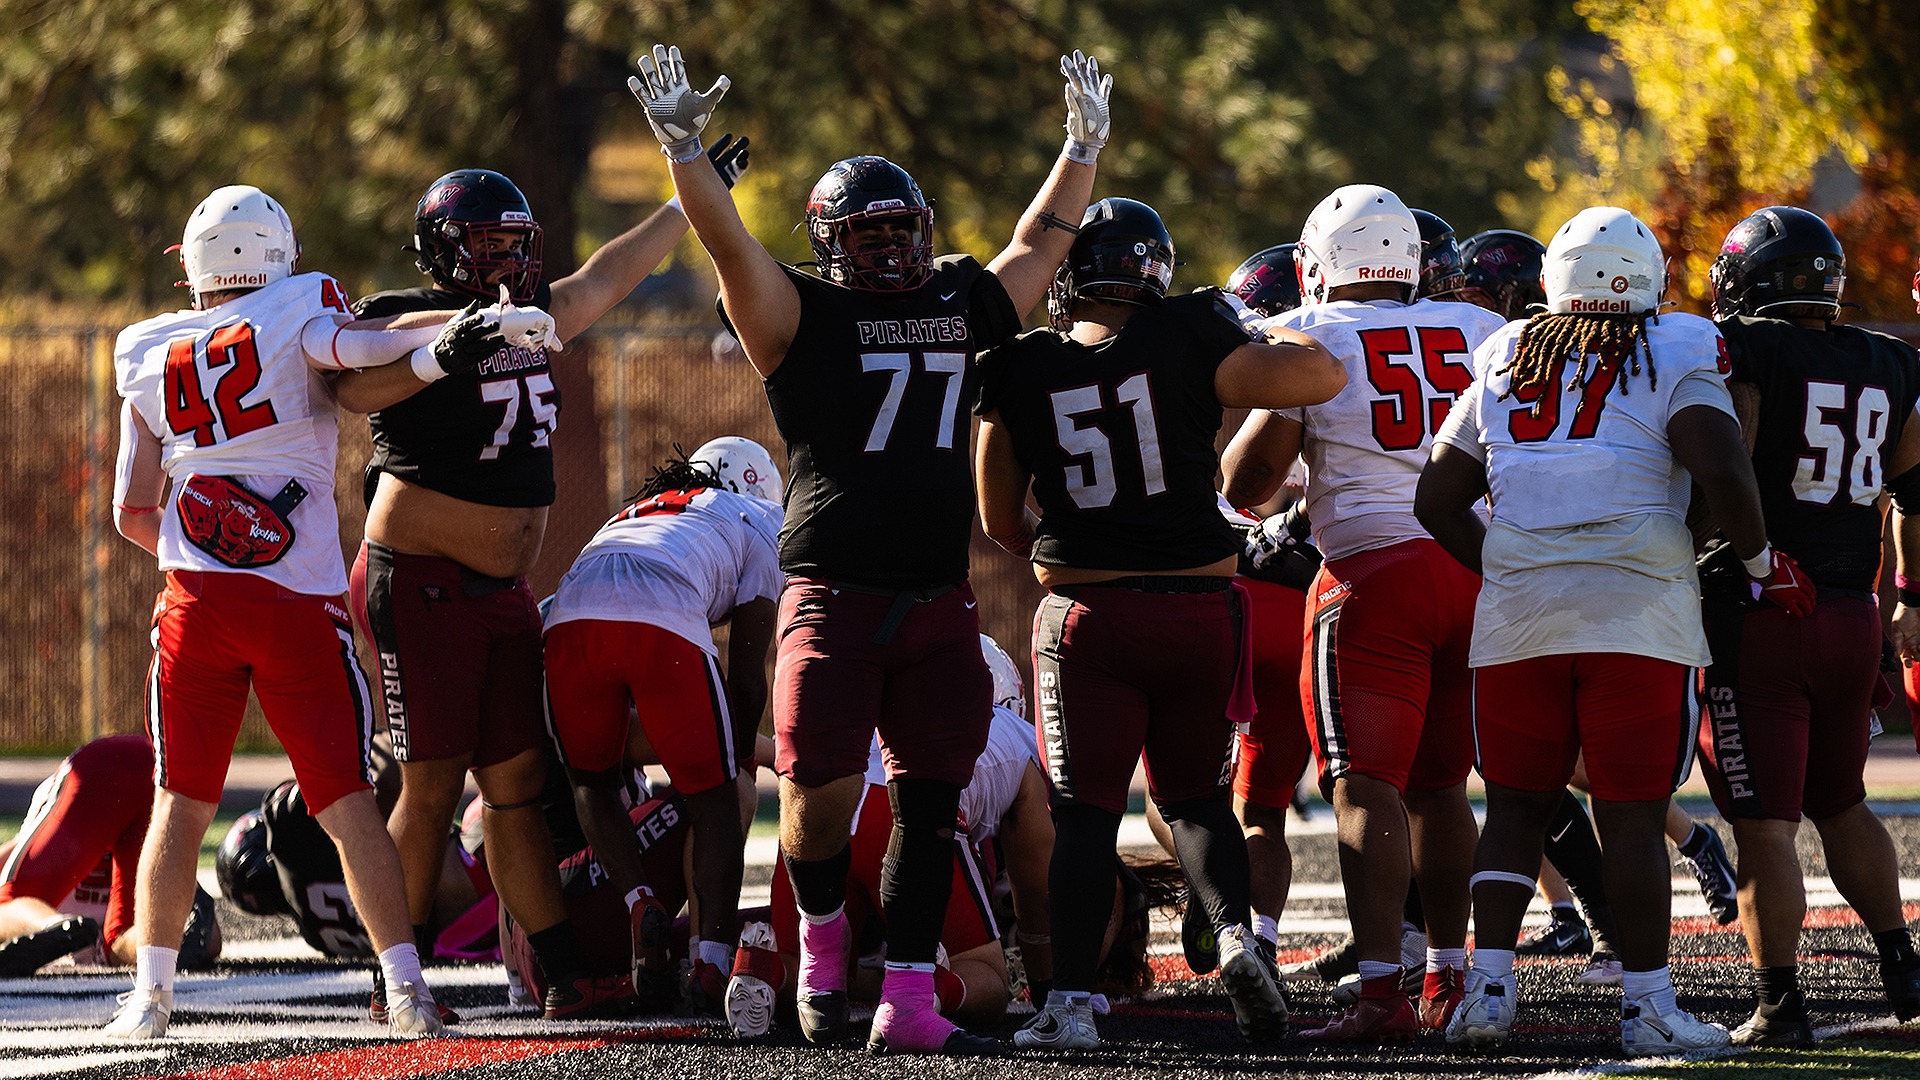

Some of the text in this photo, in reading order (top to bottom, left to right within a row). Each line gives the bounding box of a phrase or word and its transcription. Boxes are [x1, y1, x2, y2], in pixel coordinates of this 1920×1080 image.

[213, 273, 267, 285] Riddell
[1358, 266, 1412, 280] Riddell
[1571, 299, 1630, 313] Riddell
[478, 346, 548, 376] PIRATES
[857, 316, 968, 345] PIRATES
[164, 322, 279, 448] 42
[478, 372, 559, 462] 75
[859, 351, 968, 452] 77
[1356, 326, 1475, 449] 55
[1508, 337, 1631, 444] 97
[1048, 370, 1168, 509] 51
[1791, 379, 1891, 507] 58
[185, 486, 213, 508] SHOCK
[324, 601, 350, 621] PACIFIC
[1318, 580, 1352, 604] PACIFIC
[381, 652, 408, 762] PIRATES
[1040, 671, 1069, 784] PIRATES
[1710, 686, 1755, 800] PIRATES
